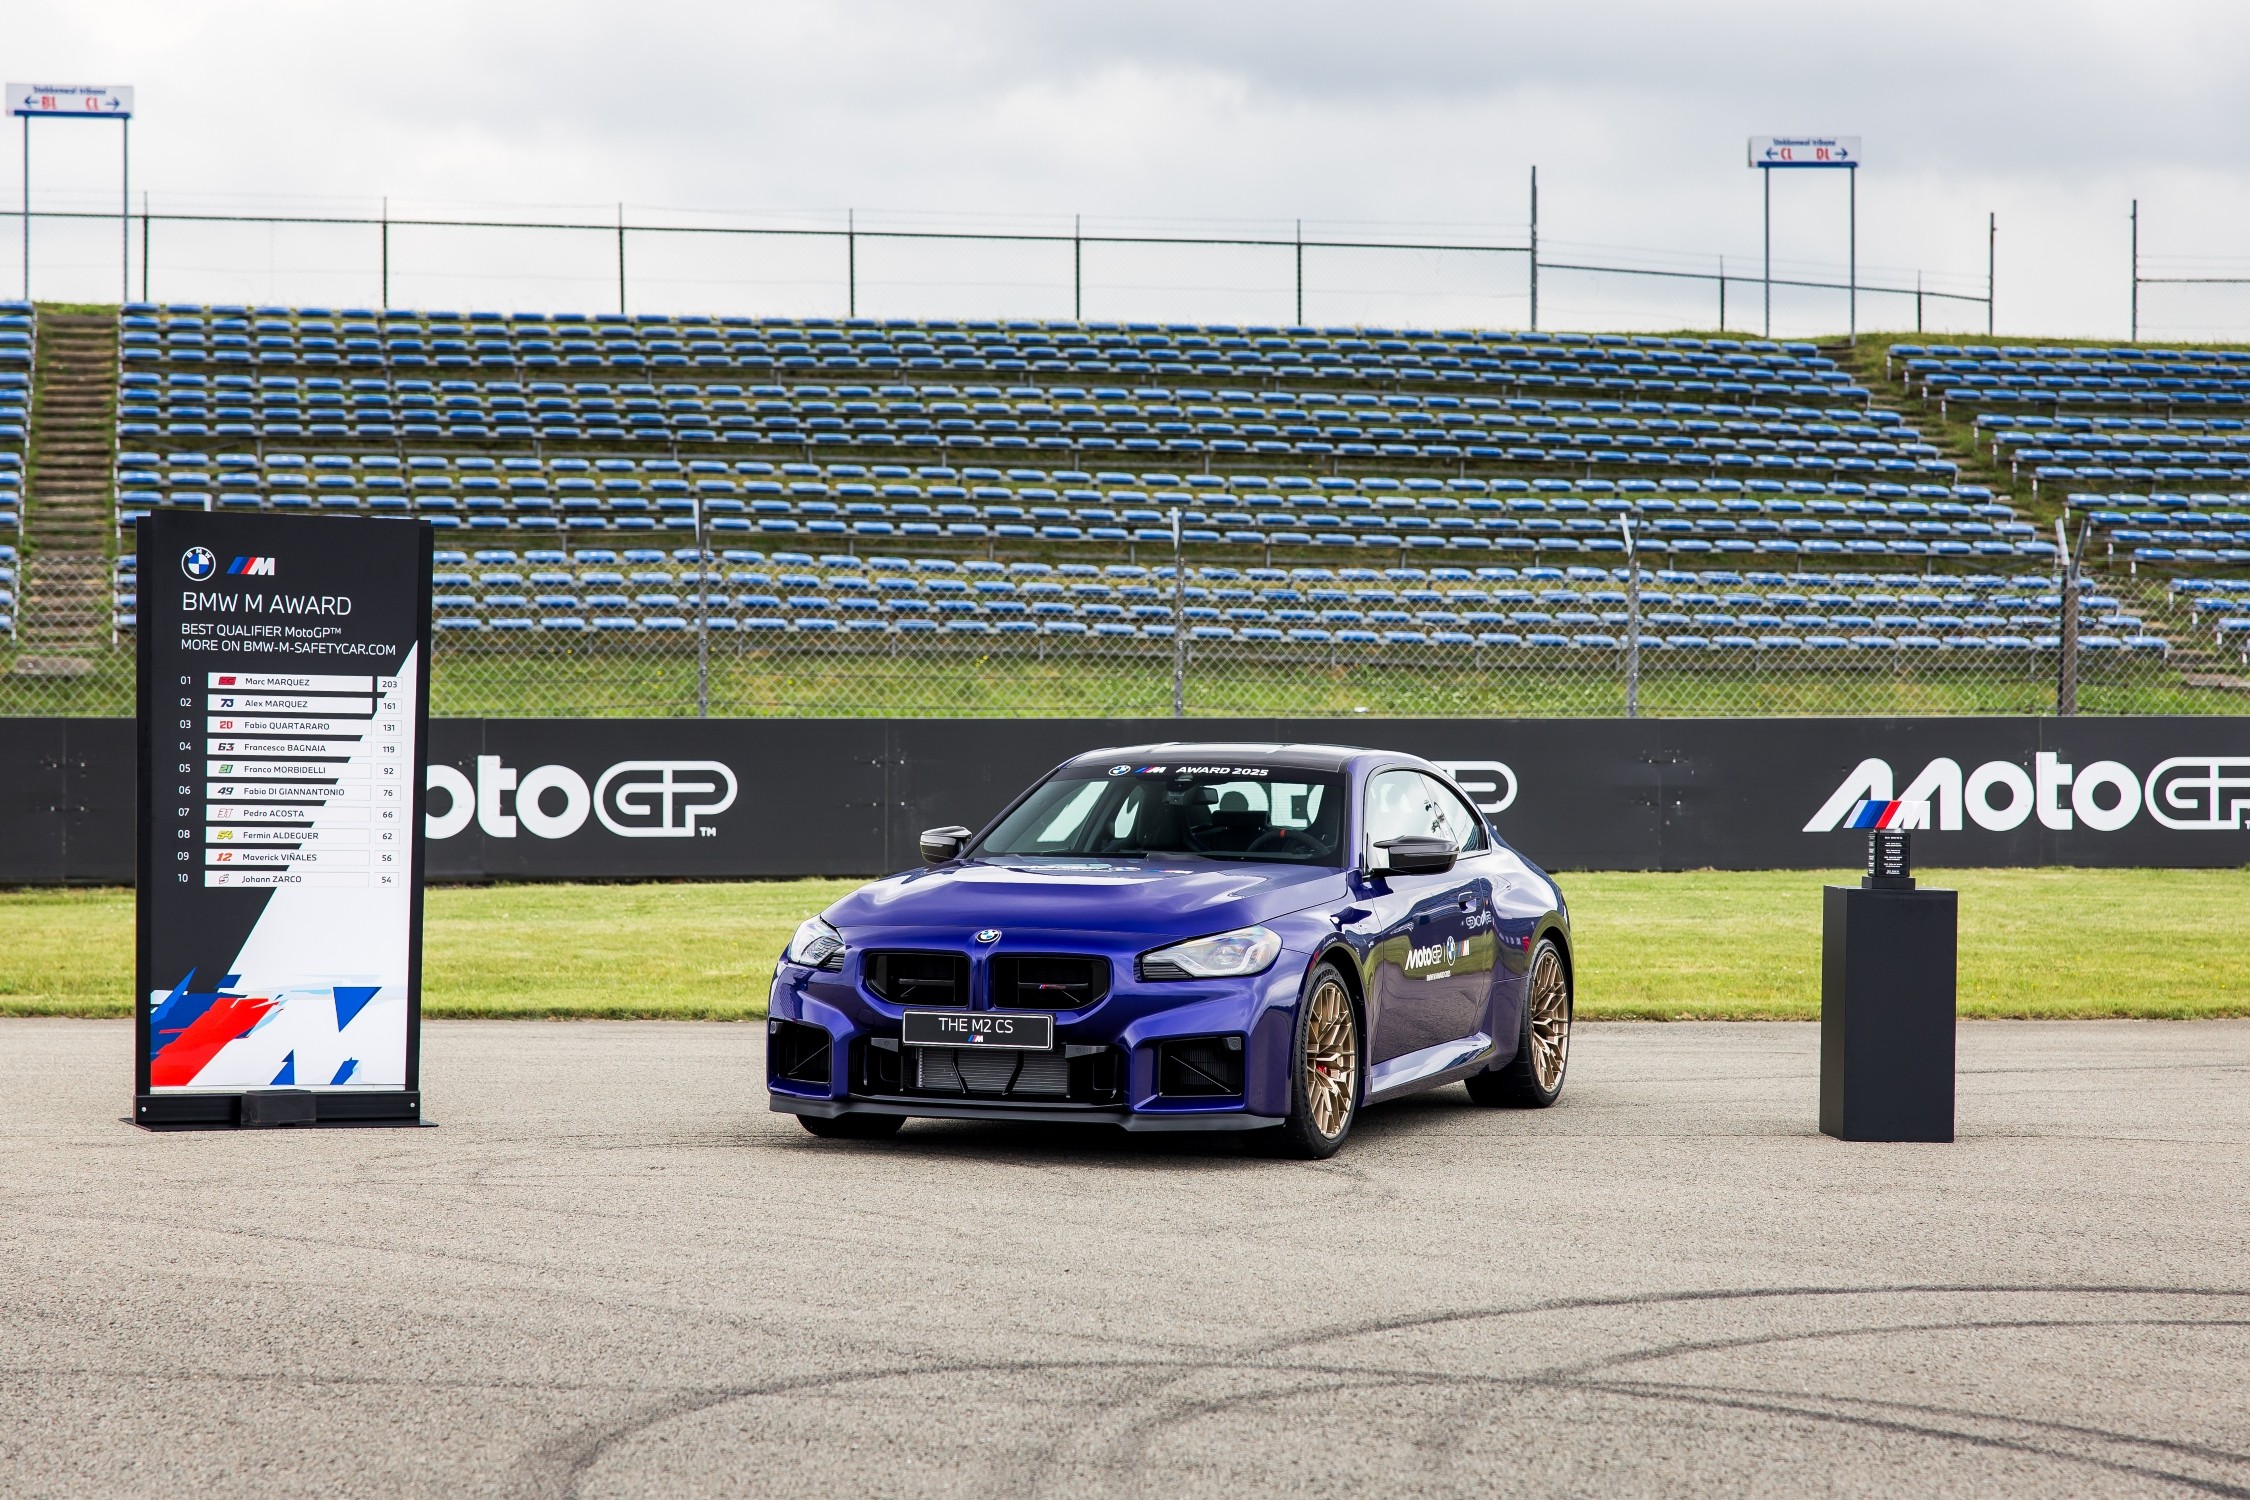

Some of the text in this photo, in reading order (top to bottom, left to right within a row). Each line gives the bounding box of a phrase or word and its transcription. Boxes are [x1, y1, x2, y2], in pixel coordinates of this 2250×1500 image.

[182, 592, 352, 616] BMW M AWARD
[181, 623, 214, 636] BEST
[216, 624, 282, 638] QUALIFIER
[181, 639, 396, 656] MORE ON BMW-M-SAFETYCAR.COM
[180, 676, 191, 686] 01
[245, 677, 265, 686] Marc
[267, 678, 310, 687] MARQUEZ
[382, 680, 398, 688] 203
[180, 698, 396, 710] 02 73 Alex MARQUEZ 161
[179, 720, 396, 732] 03 20 Fabio QUARTARARO 131
[179, 742, 395, 754] 04 63 Francesco BAGNAIA 119
[179, 764, 191, 773] 05
[244, 765, 272, 774] Franco
[273, 766, 326, 775] MORBIDELLI
[383, 767, 394, 776] 92
[1176, 766, 1230, 775] AWARD
[1232, 767, 1269, 776] 2025
[178, 786, 393, 797] 06 49 Fabio DI GIANNANTONIO 76
[425, 755, 738, 839] otoGP
[178, 808, 190, 817] 07
[243, 809, 267, 818] Pedro
[269, 810, 305, 818] ACOSTA
[382, 811, 393, 819] 66
[177, 830, 191, 839] 08
[216, 830, 234, 840] 54
[243, 831, 271, 840] Fermin
[272, 831, 319, 840] ALDEGUER
[177, 852, 190, 861] 09
[242, 853, 279, 862] Maverick
[280, 852, 317, 862] VIÑALES
[382, 854, 392, 862] 56
[177, 874, 188, 883] 10
[241, 875, 271, 884] Johann
[272, 876, 302, 884] ZARCO
[1405, 943, 1442, 971] MotoGP
[938, 1017, 1014, 1034] THE M2 CS
